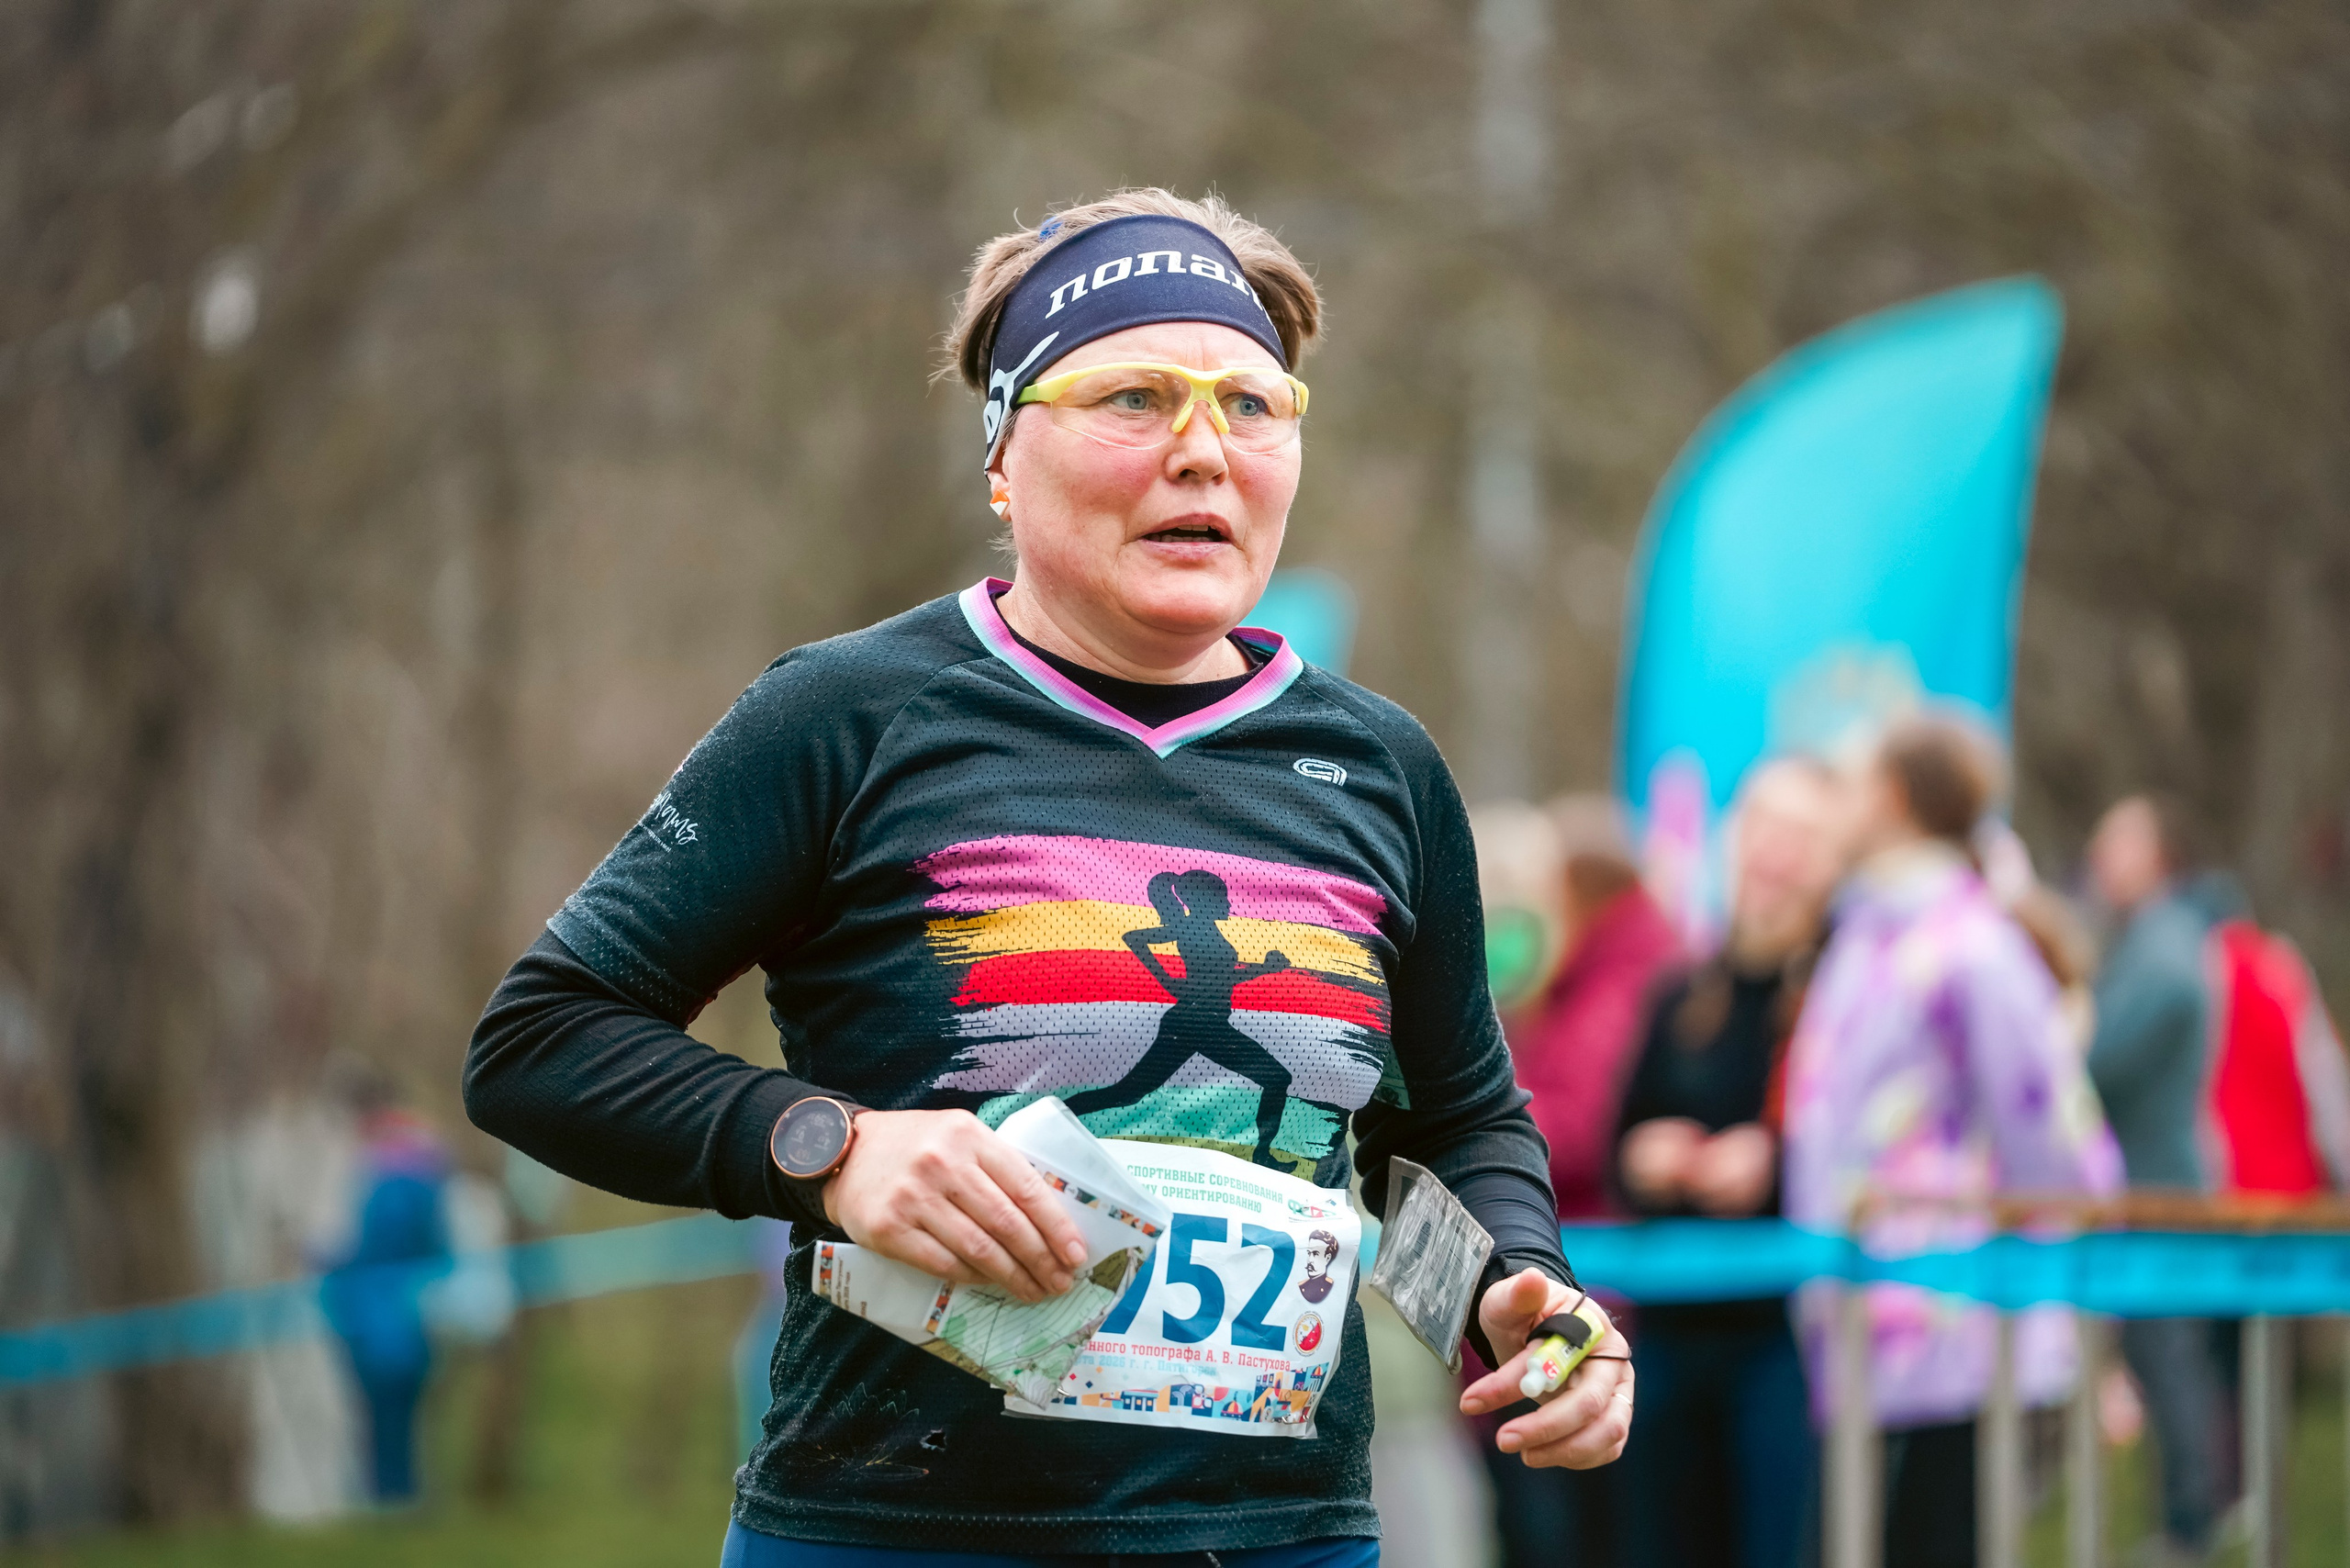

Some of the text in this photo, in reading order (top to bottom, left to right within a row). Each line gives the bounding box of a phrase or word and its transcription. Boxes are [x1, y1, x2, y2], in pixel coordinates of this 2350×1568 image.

[1127, 1165, 1283, 1204] СПОРТИВНЫЕ СОРЕВНОВАНИЯ
[1161, 1185, 1262, 1214] ОРИЕНТИРОВАНИЮ
[1132, 1344, 1202, 1362] топографа
[1205, 1349, 1217, 1362] А.
[1222, 1351, 1233, 1364] В.
[1238, 1353, 1292, 1372] Пастухова
